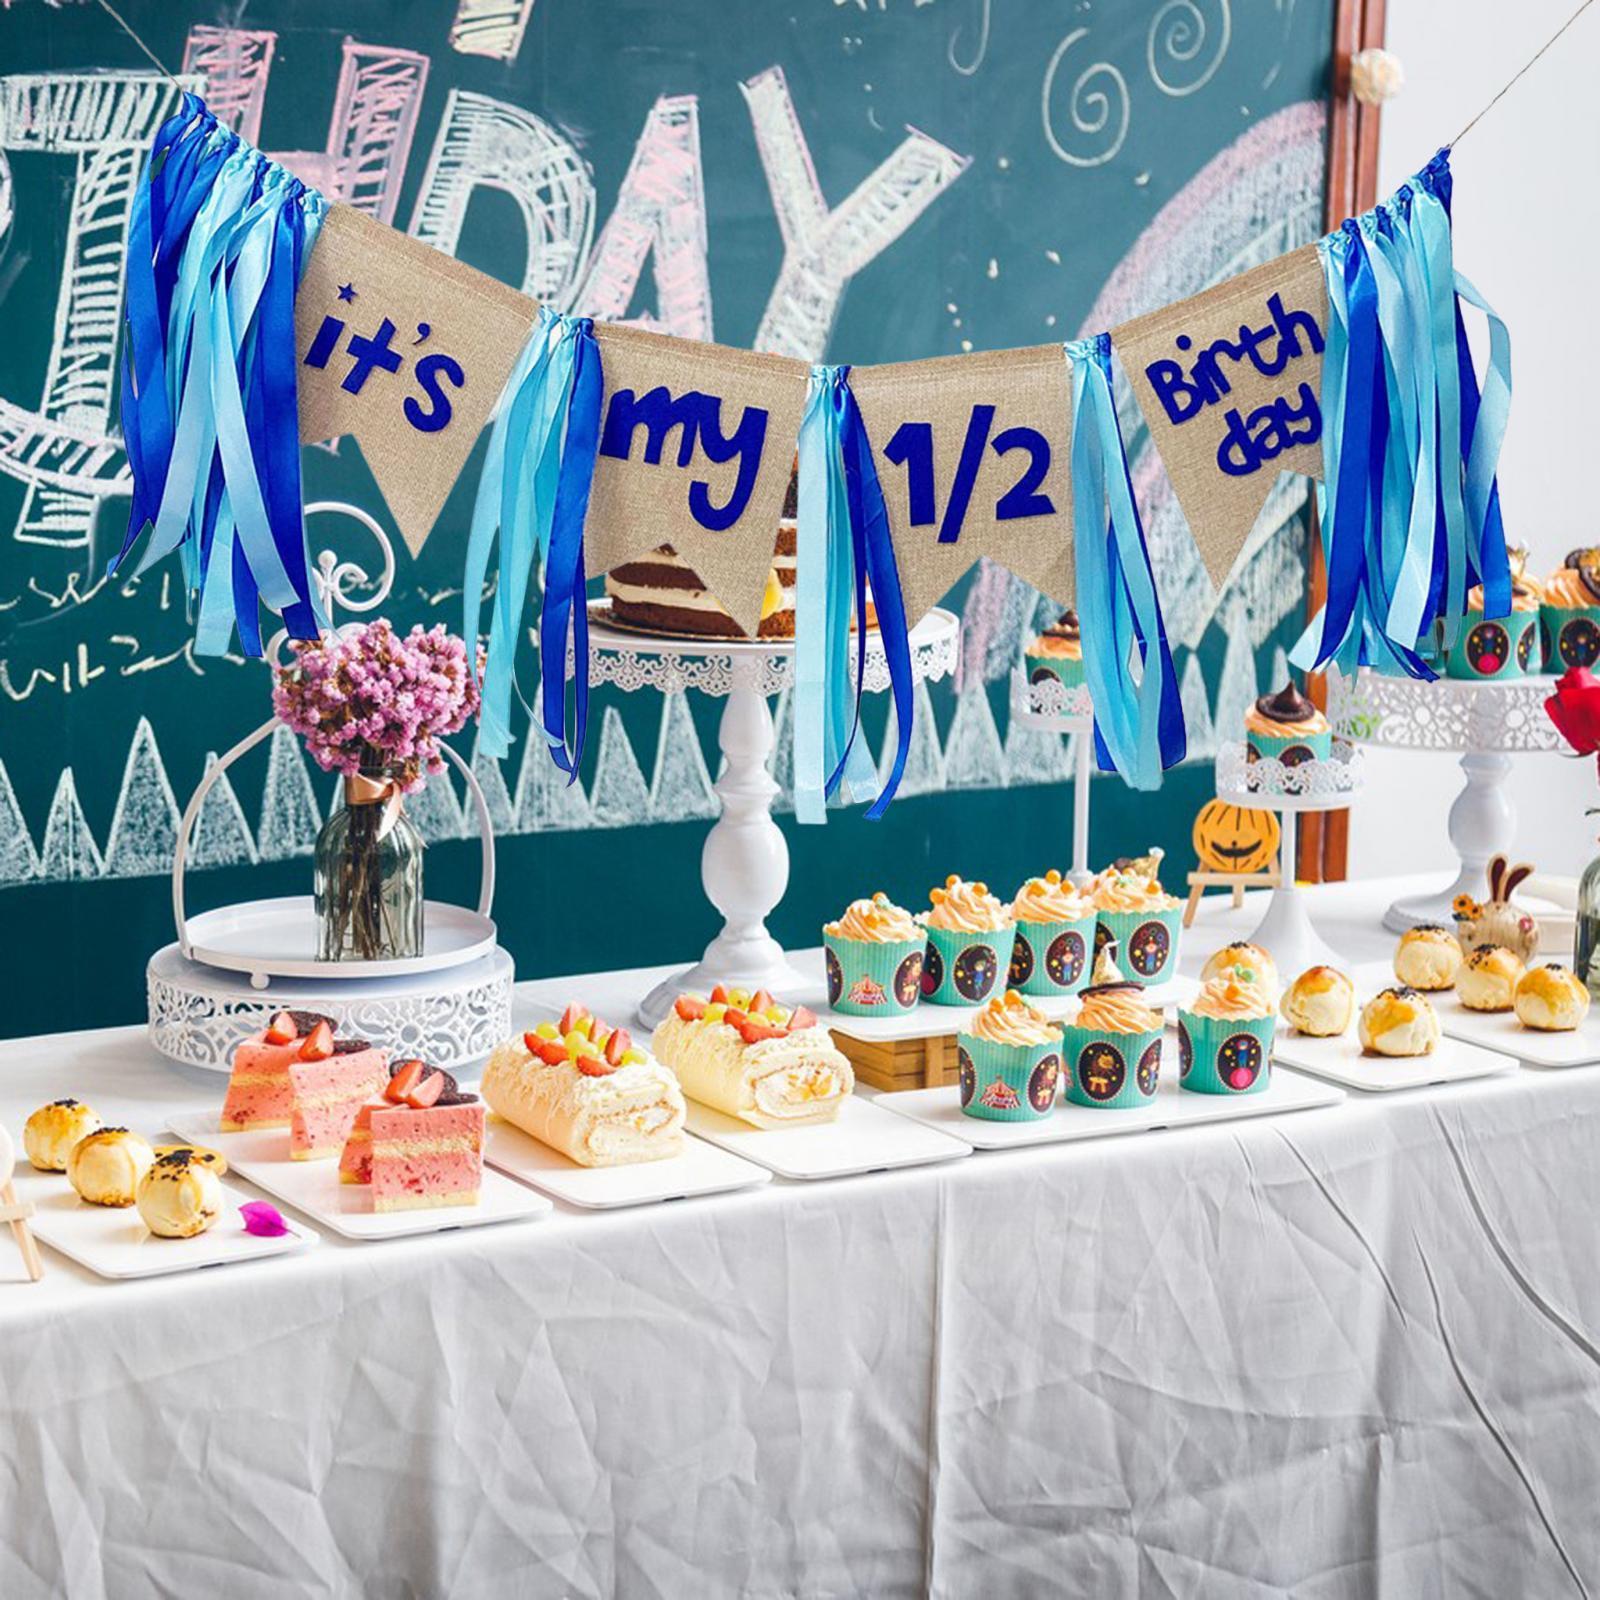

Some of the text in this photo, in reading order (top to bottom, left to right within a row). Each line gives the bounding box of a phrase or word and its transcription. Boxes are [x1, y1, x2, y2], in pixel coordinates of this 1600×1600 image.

[0, 25, 970, 545] THDAY
[304, 282, 1326, 543] it's my 1/2 Birth
[1217, 382, 1323, 476] day
